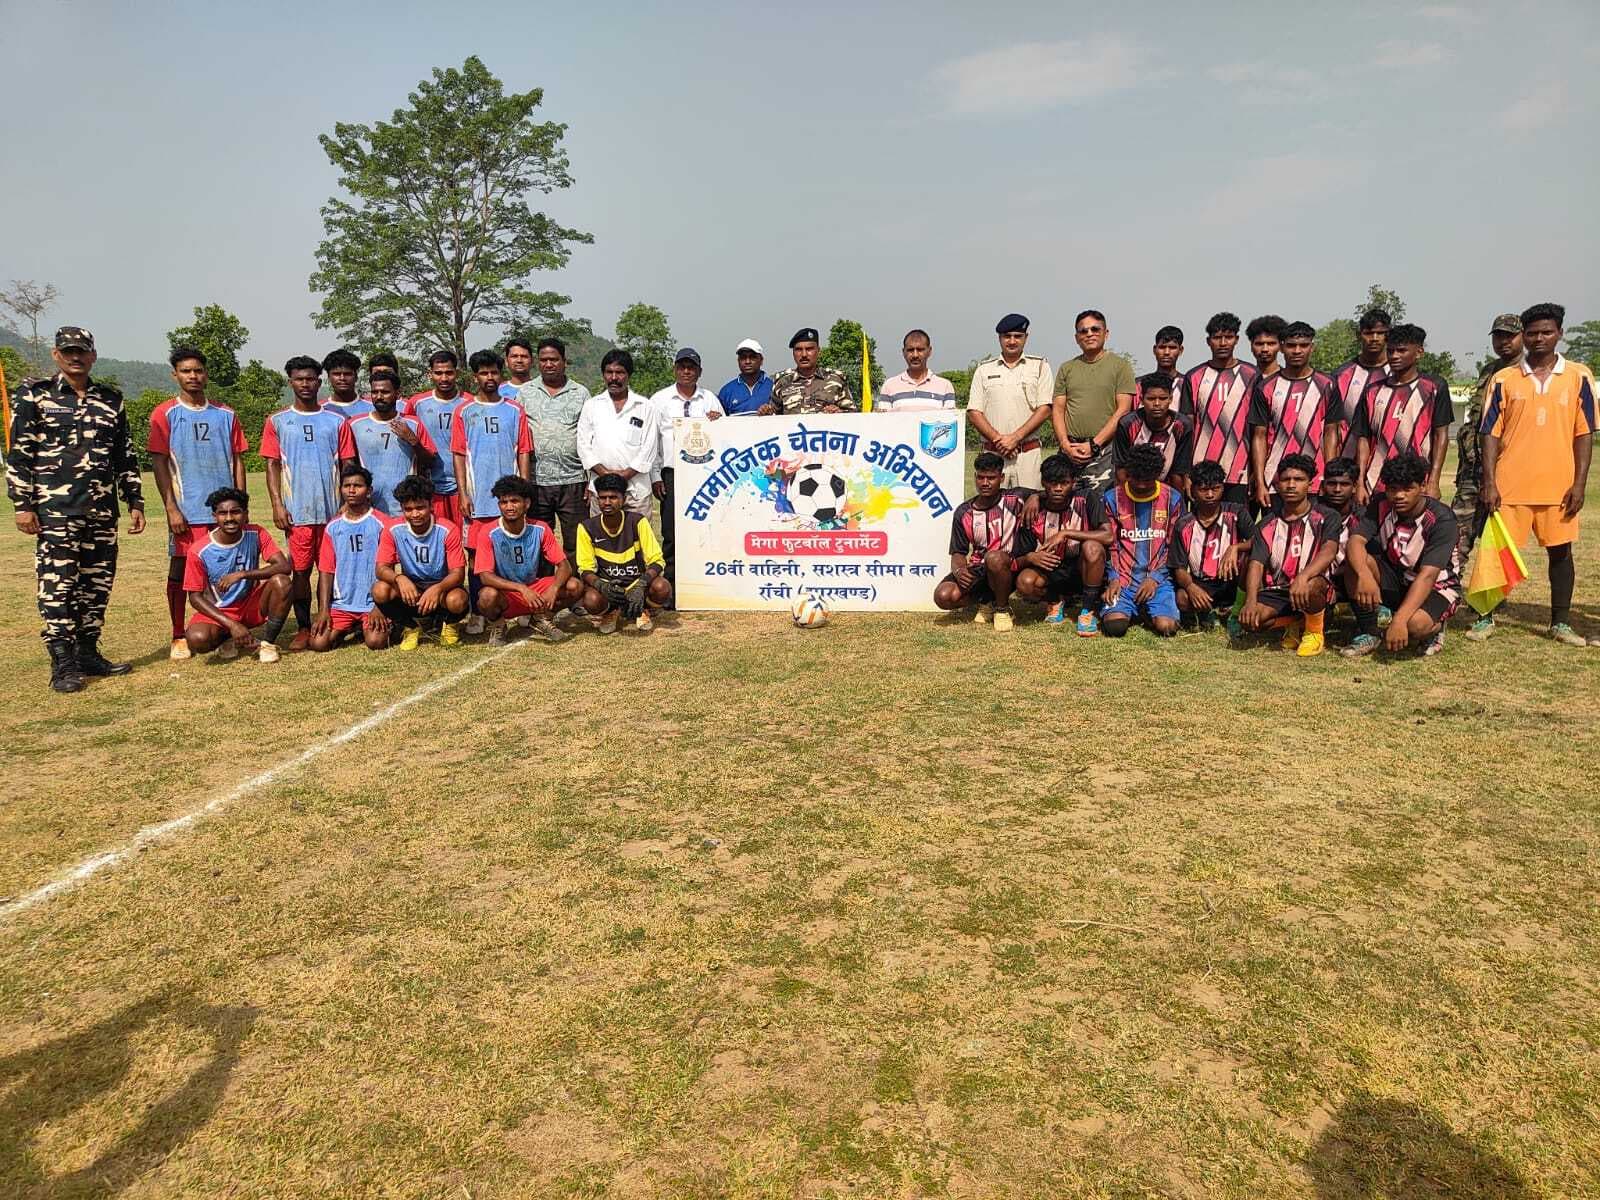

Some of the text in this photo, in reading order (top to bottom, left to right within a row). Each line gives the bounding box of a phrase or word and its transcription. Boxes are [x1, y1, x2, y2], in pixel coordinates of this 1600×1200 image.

[1291, 392, 1304, 412] 7
[438, 413, 452, 430] 17
[484, 416, 499, 434] 15
[193, 422, 211, 441] 12
[303, 424, 314, 442] 9
[381, 432, 391, 449] 7
[684, 422, 953, 523] सामाजिक चेतना अभियान
[1120, 527, 1166, 539] Rakuten
[751, 535, 777, 548] मेगा
[781, 535, 832, 553] फुटबॉल
[1208, 539, 1221, 560] 2
[1291, 535, 1302, 557] 6
[414, 545, 430, 564] 10
[513, 546, 524, 564] 8
[704, 560, 937, 577] 26वीं वाहिनी, सशस्त्र सीमा बल
